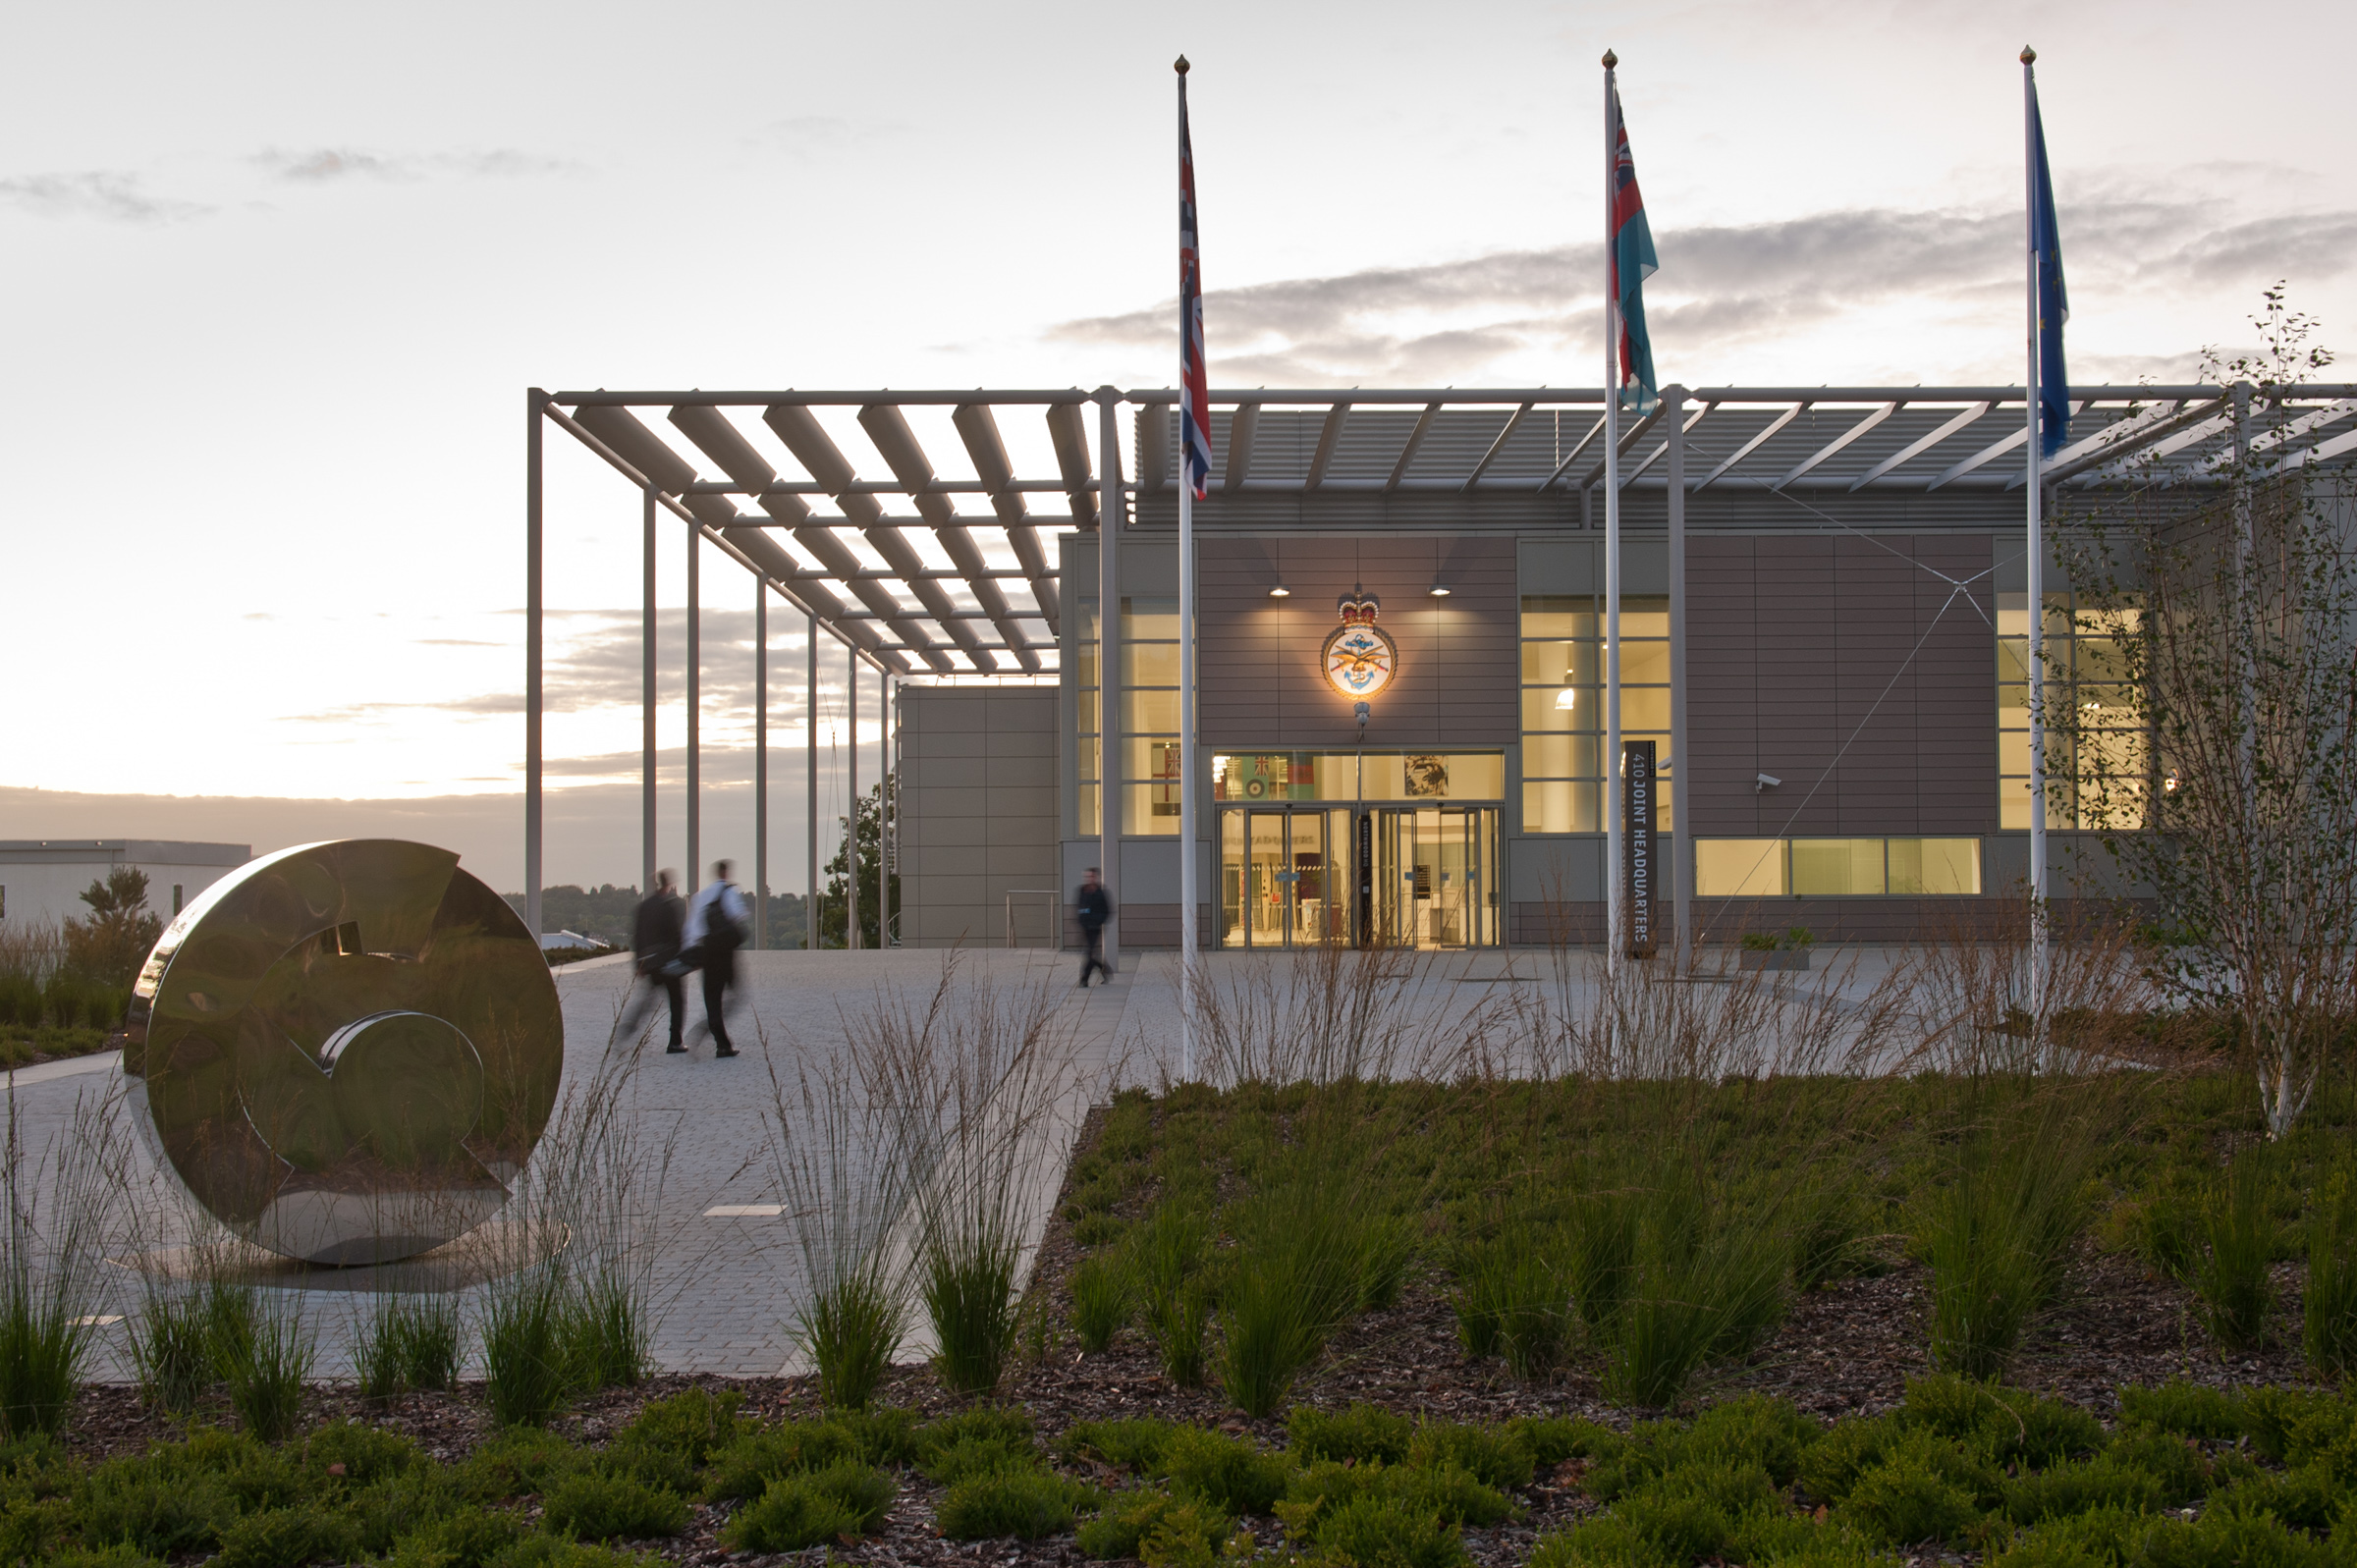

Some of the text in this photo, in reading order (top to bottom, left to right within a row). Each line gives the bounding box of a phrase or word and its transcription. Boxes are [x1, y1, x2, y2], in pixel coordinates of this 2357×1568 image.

[1632, 753, 1648, 943] 410 JOINT HEADQUARTERS
